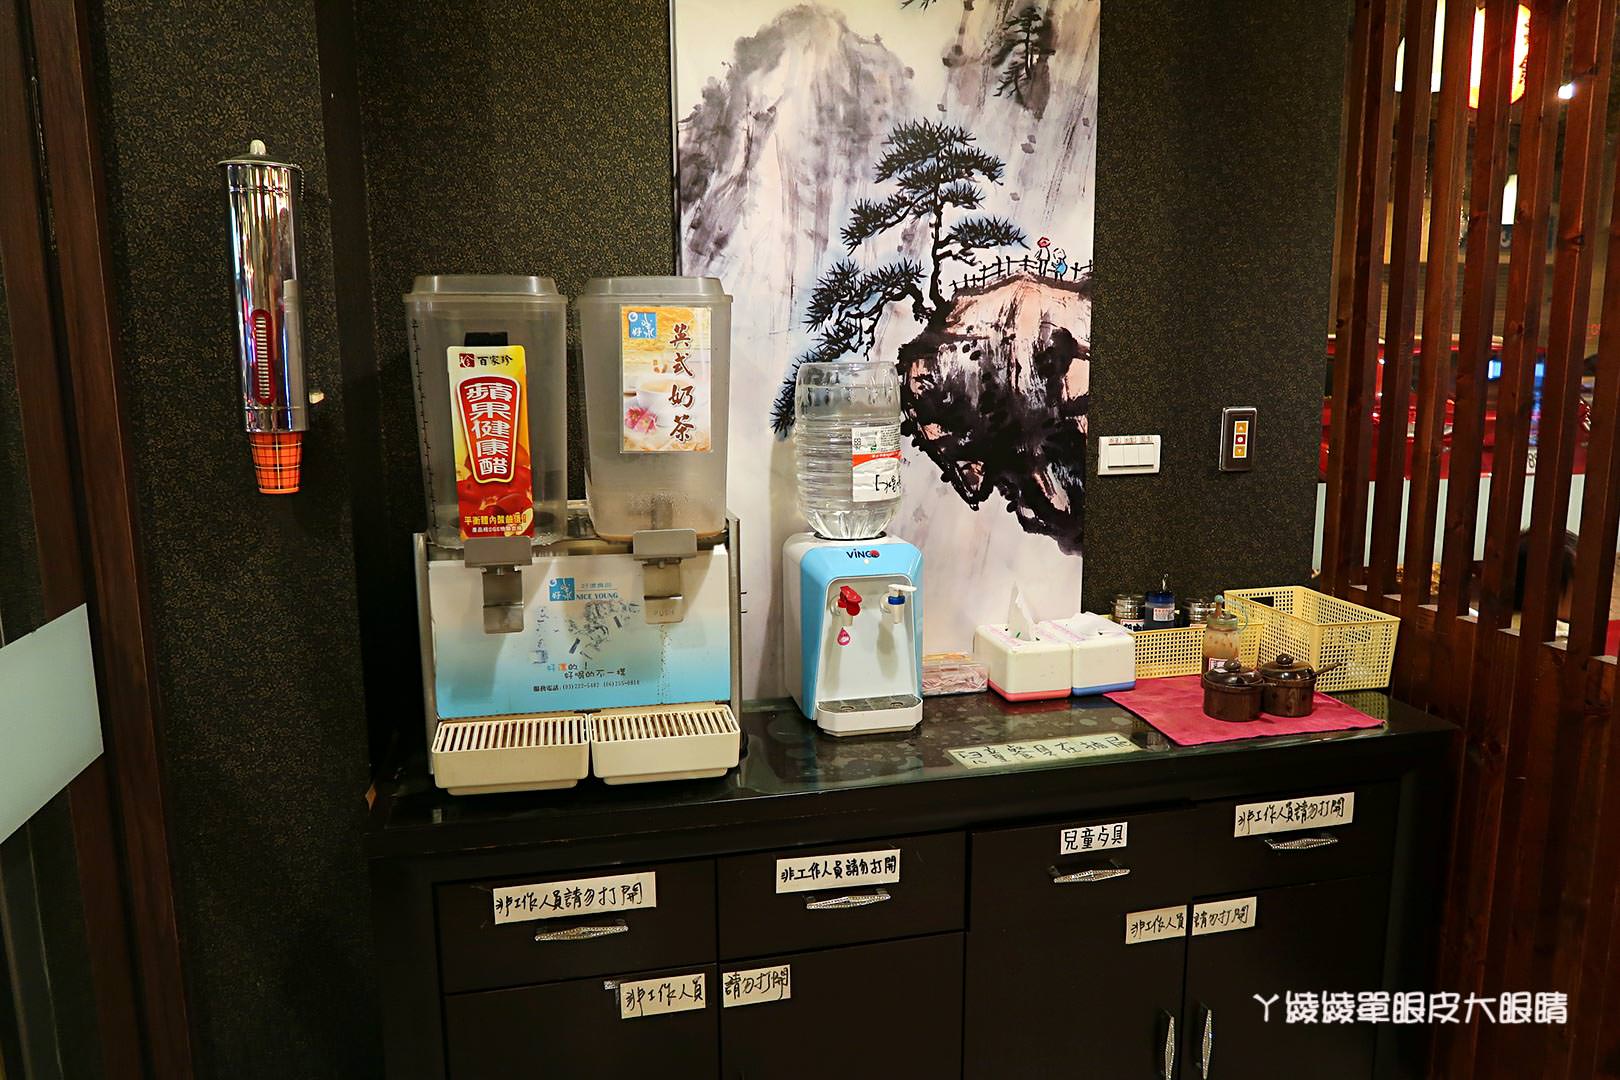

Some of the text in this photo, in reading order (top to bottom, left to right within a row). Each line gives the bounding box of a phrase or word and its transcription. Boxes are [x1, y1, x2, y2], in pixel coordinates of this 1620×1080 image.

[477, 355, 513, 366] 百家珍
[669, 323, 694, 441] 英式奶茶
[464, 382, 513, 475] 蘋果健康醋
[576, 592, 619, 601] NICE YOUNG
[1237, 797, 1346, 834] 非工作人員請勿打開
[781, 855, 897, 883] 非工作人員請勿打開
[495, 882, 644, 917] 非工作人員請勿打開
[625, 967, 789, 1017] 非工作人員 請勿打開
